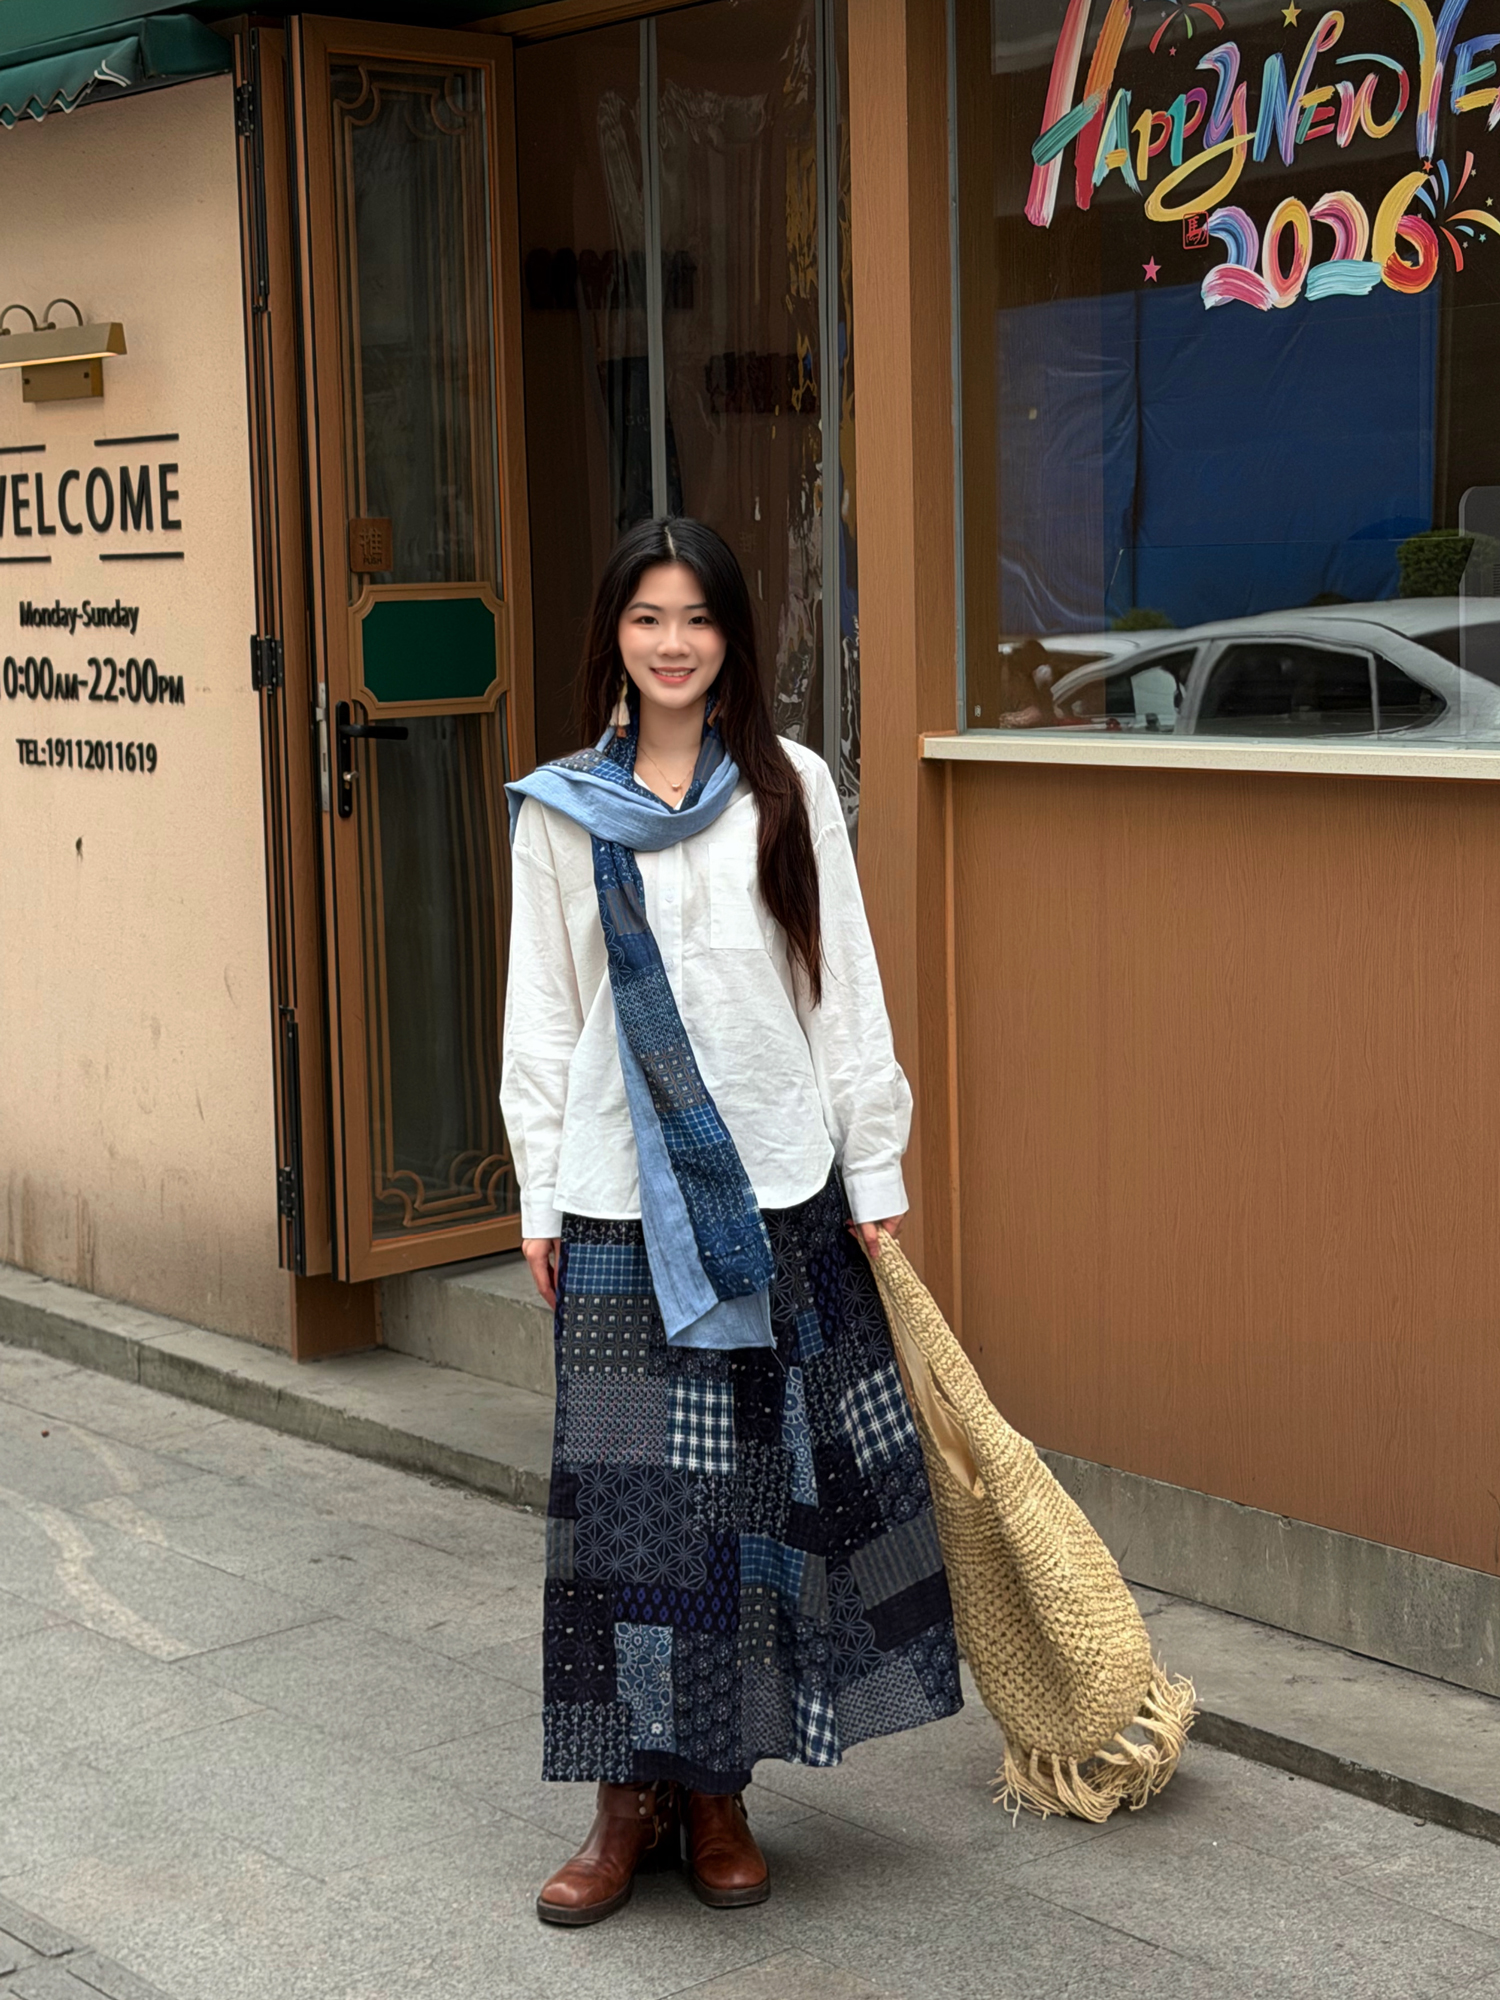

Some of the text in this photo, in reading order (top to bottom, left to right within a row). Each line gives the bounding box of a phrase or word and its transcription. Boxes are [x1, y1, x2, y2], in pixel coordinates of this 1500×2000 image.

[1389, 0, 1500, 160] YE
[1201, 171, 1439, 311] 2026
[0, 463, 182, 538] ELCOME
[359, 527, 383, 556] 推
[363, 555, 384, 566] PUSH
[19, 599, 139, 635] Monday-Sunday
[0, 656, 185, 706] 0:00AM-22:00PM
[15, 737, 158, 773] TEL:19112011619
